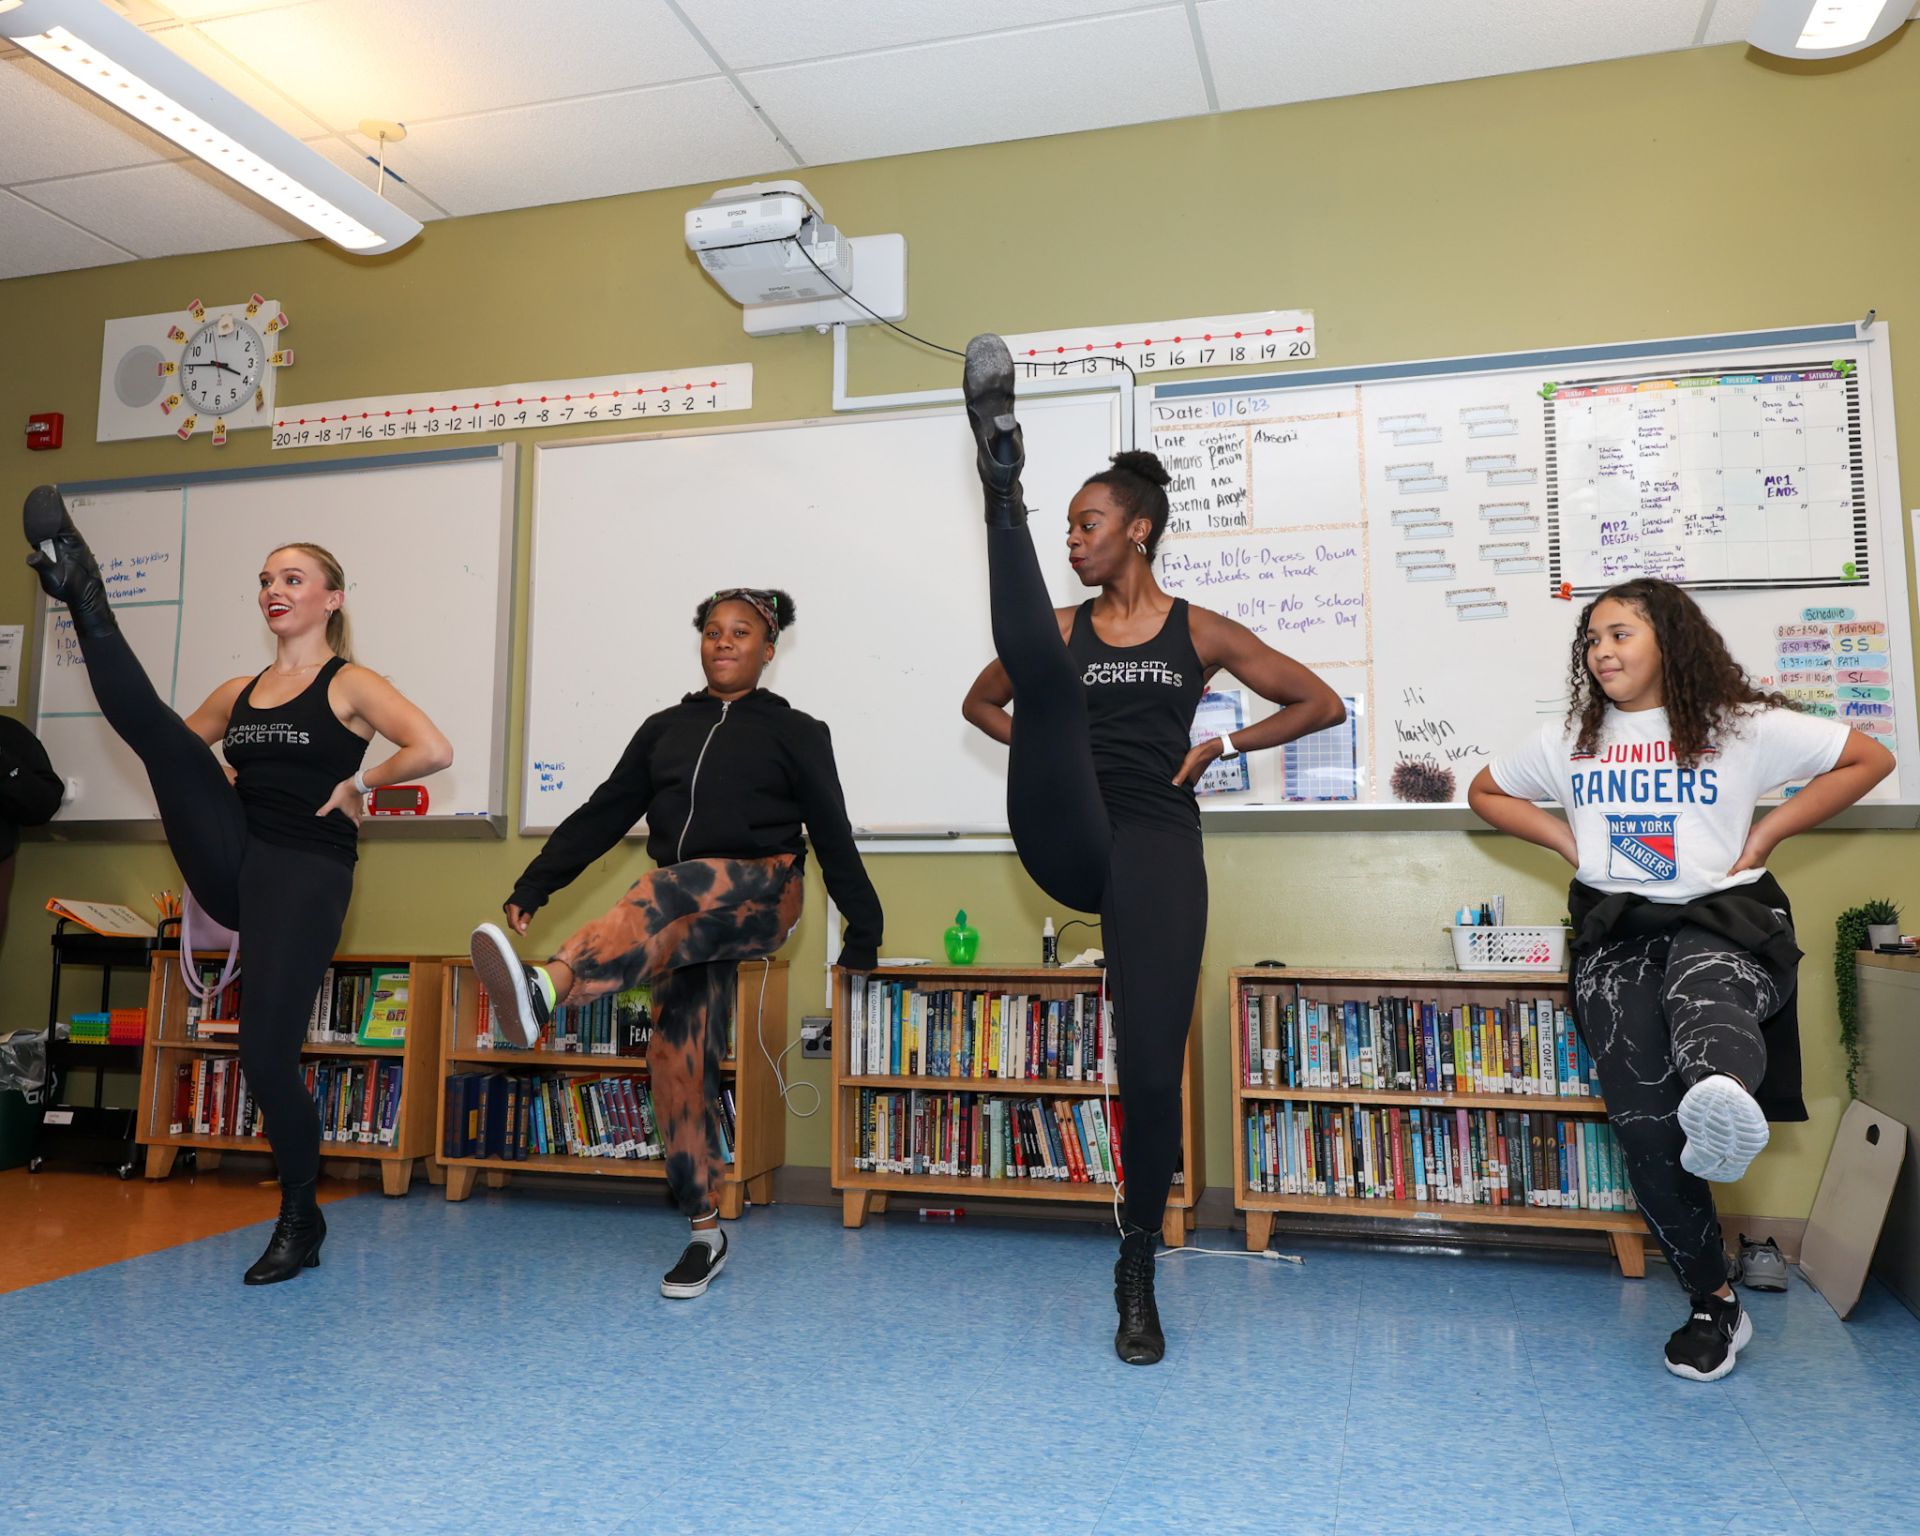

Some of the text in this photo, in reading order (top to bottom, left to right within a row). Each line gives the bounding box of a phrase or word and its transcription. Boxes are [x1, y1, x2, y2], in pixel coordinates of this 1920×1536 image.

[204, 333, 212, 343] 11
[192, 346, 201, 357] 10
[245, 341, 251, 352] 2
[248, 358, 254, 368] 3
[1053, 361, 1068, 376] 12
[1082, 359, 1097, 373] 13
[1140, 353, 1155, 368] 15
[1170, 351, 1185, 365] 16
[1200, 349, 1215, 363] 17
[1230, 347, 1245, 361] 18
[1261, 344, 1277, 359] 19
[1289, 342, 1311, 357] 20
[243, 376, 248, 386] 4
[1771, 374, 1792, 382] FRIDAY
[1808, 372, 1837, 380] SATURDAY
[191, 380, 197, 391] 8
[201, 391, 207, 402] 7
[231, 389, 236, 399] 5
[215, 395, 220, 405] 6
[273, 395, 716, 446] -20 -19 -18 -17 -16 -15 -14 -13 -12 -11 -10 -9 -8 -7 -6 -5 -4 -3 -2 -1
[1765, 475, 1792, 486] MP1
[1767, 487, 1798, 498] ENDS
[1208, 512, 1247, 528] Isaiah
[1601, 520, 1629, 533] MP2
[1601, 534, 1639, 546] BEGINS
[1162, 552, 1212, 576] Friday
[1316, 545, 1357, 562] Down
[1196, 569, 1250, 586] students
[1283, 565, 1318, 577] track
[1315, 593, 1364, 608] School
[1806, 608, 1845, 621] Schedule
[1278, 616, 1326, 634] Peoples
[1335, 612, 1357, 627] Day
[1839, 623, 1876, 634] Advisory
[1103, 660, 1168, 670] RADIO CITY
[1838, 656, 1860, 666] PATH
[1080, 668, 1182, 687] OCKETTES
[1848, 672, 1868, 683] SL
[1404, 687, 1425, 707] Hi
[1851, 688, 1871, 698] Sci
[1846, 702, 1882, 716] MATH
[1395, 718, 1455, 746] Kaitlyn
[1572, 768, 1718, 808] RANGERS
[1611, 820, 1672, 833] NEW YORK
[1620, 837, 1673, 877] RANGERS
[1541, 1012, 1552, 1080] ON THE COME UP
